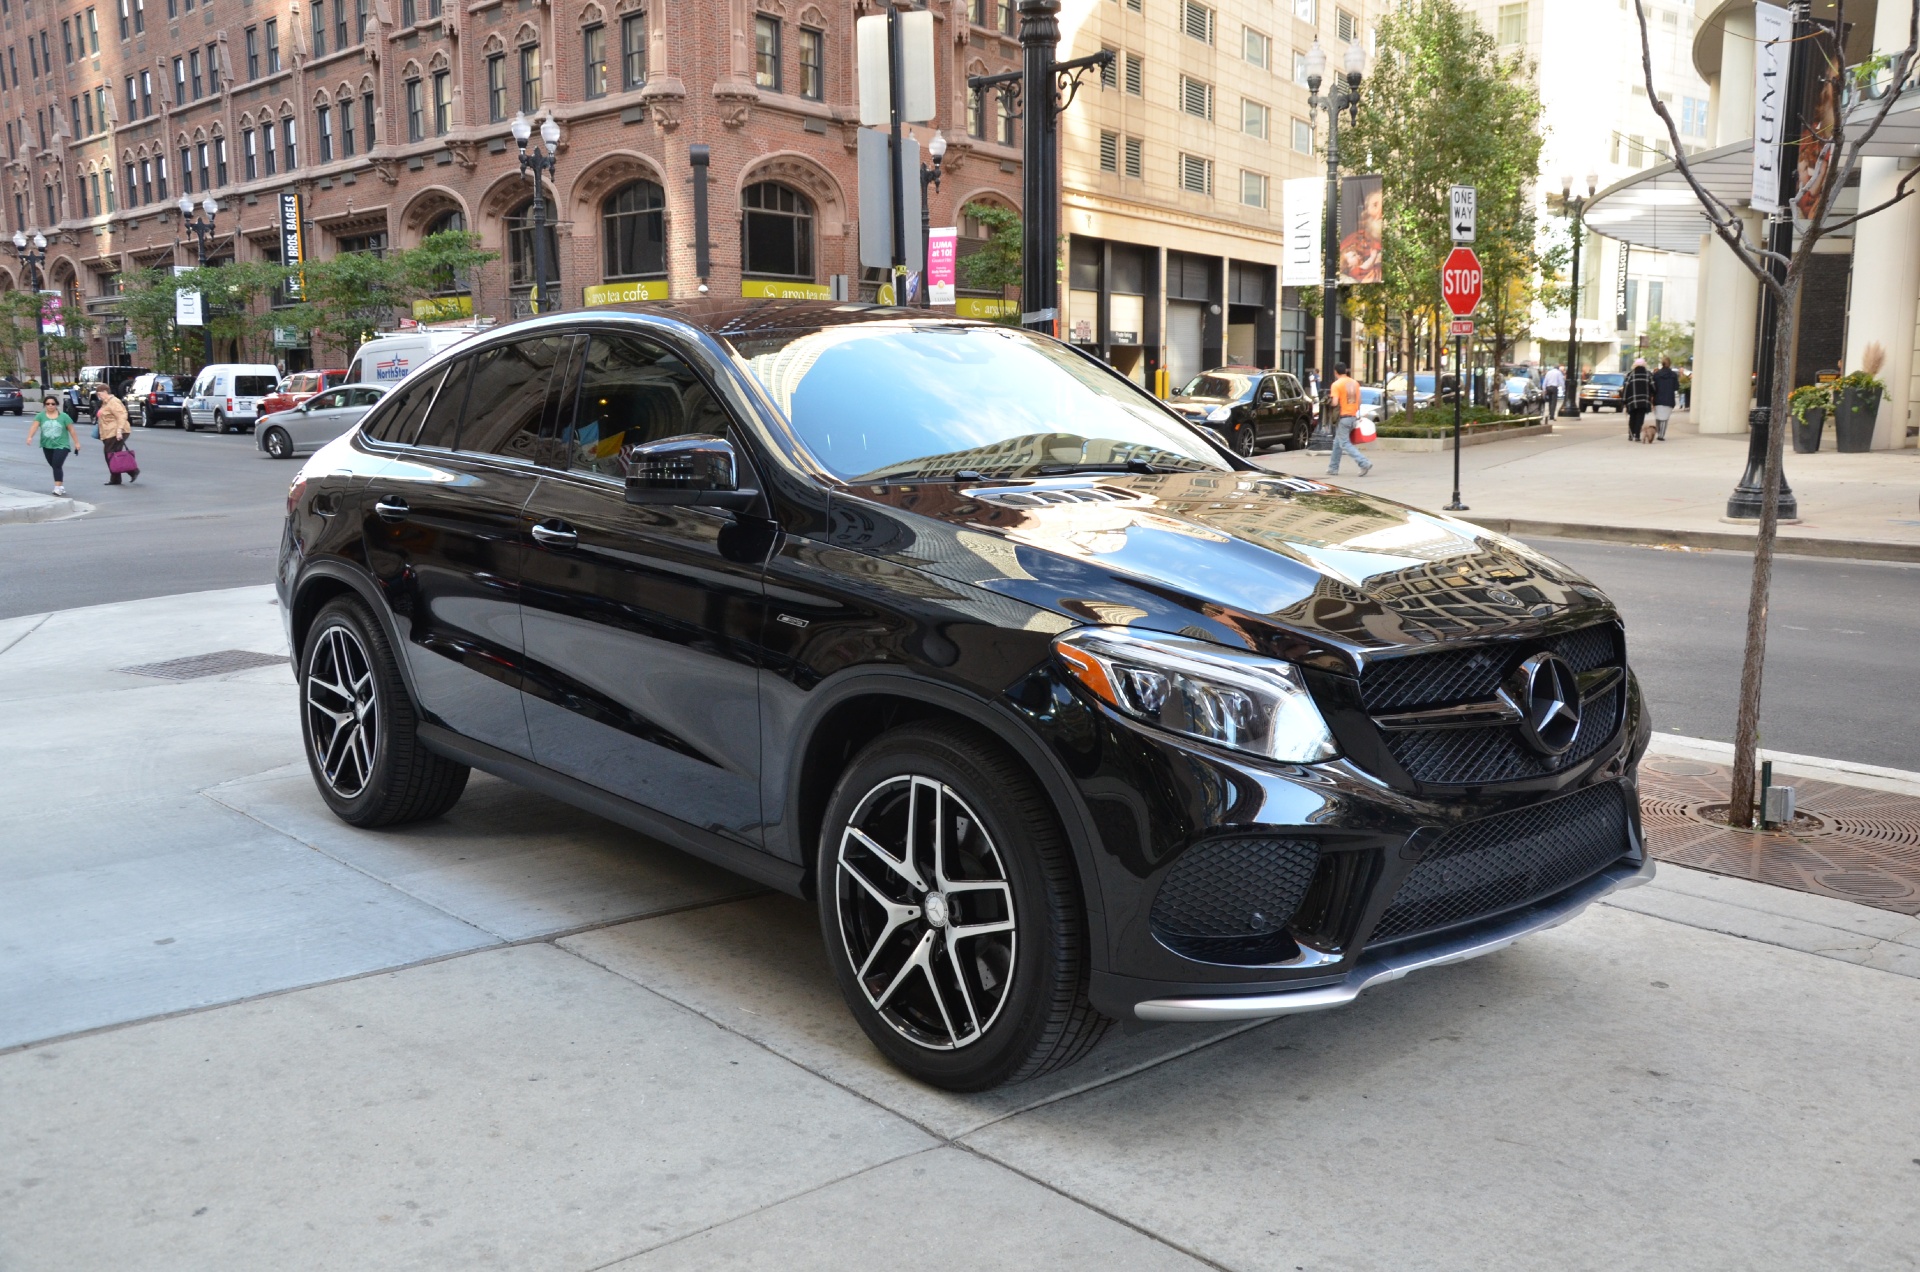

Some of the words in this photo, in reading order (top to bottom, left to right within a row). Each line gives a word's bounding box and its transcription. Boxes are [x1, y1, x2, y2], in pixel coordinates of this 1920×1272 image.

[1760, 36, 1780, 172] LUMA
[1454, 191, 1473, 205] ONE
[284, 195, 296, 231] BAGELS
[1454, 206, 1473, 220] WAY
[287, 233, 299, 257] BROS.
[932, 241, 953, 249] LUMA
[941, 249, 952, 257] 10!
[1445, 269, 1480, 295] STOP
[607, 290, 620, 302] tea
[623, 284, 649, 301] café
[1616, 292, 1627, 315] rack
[376, 366, 408, 379] NorthStar
